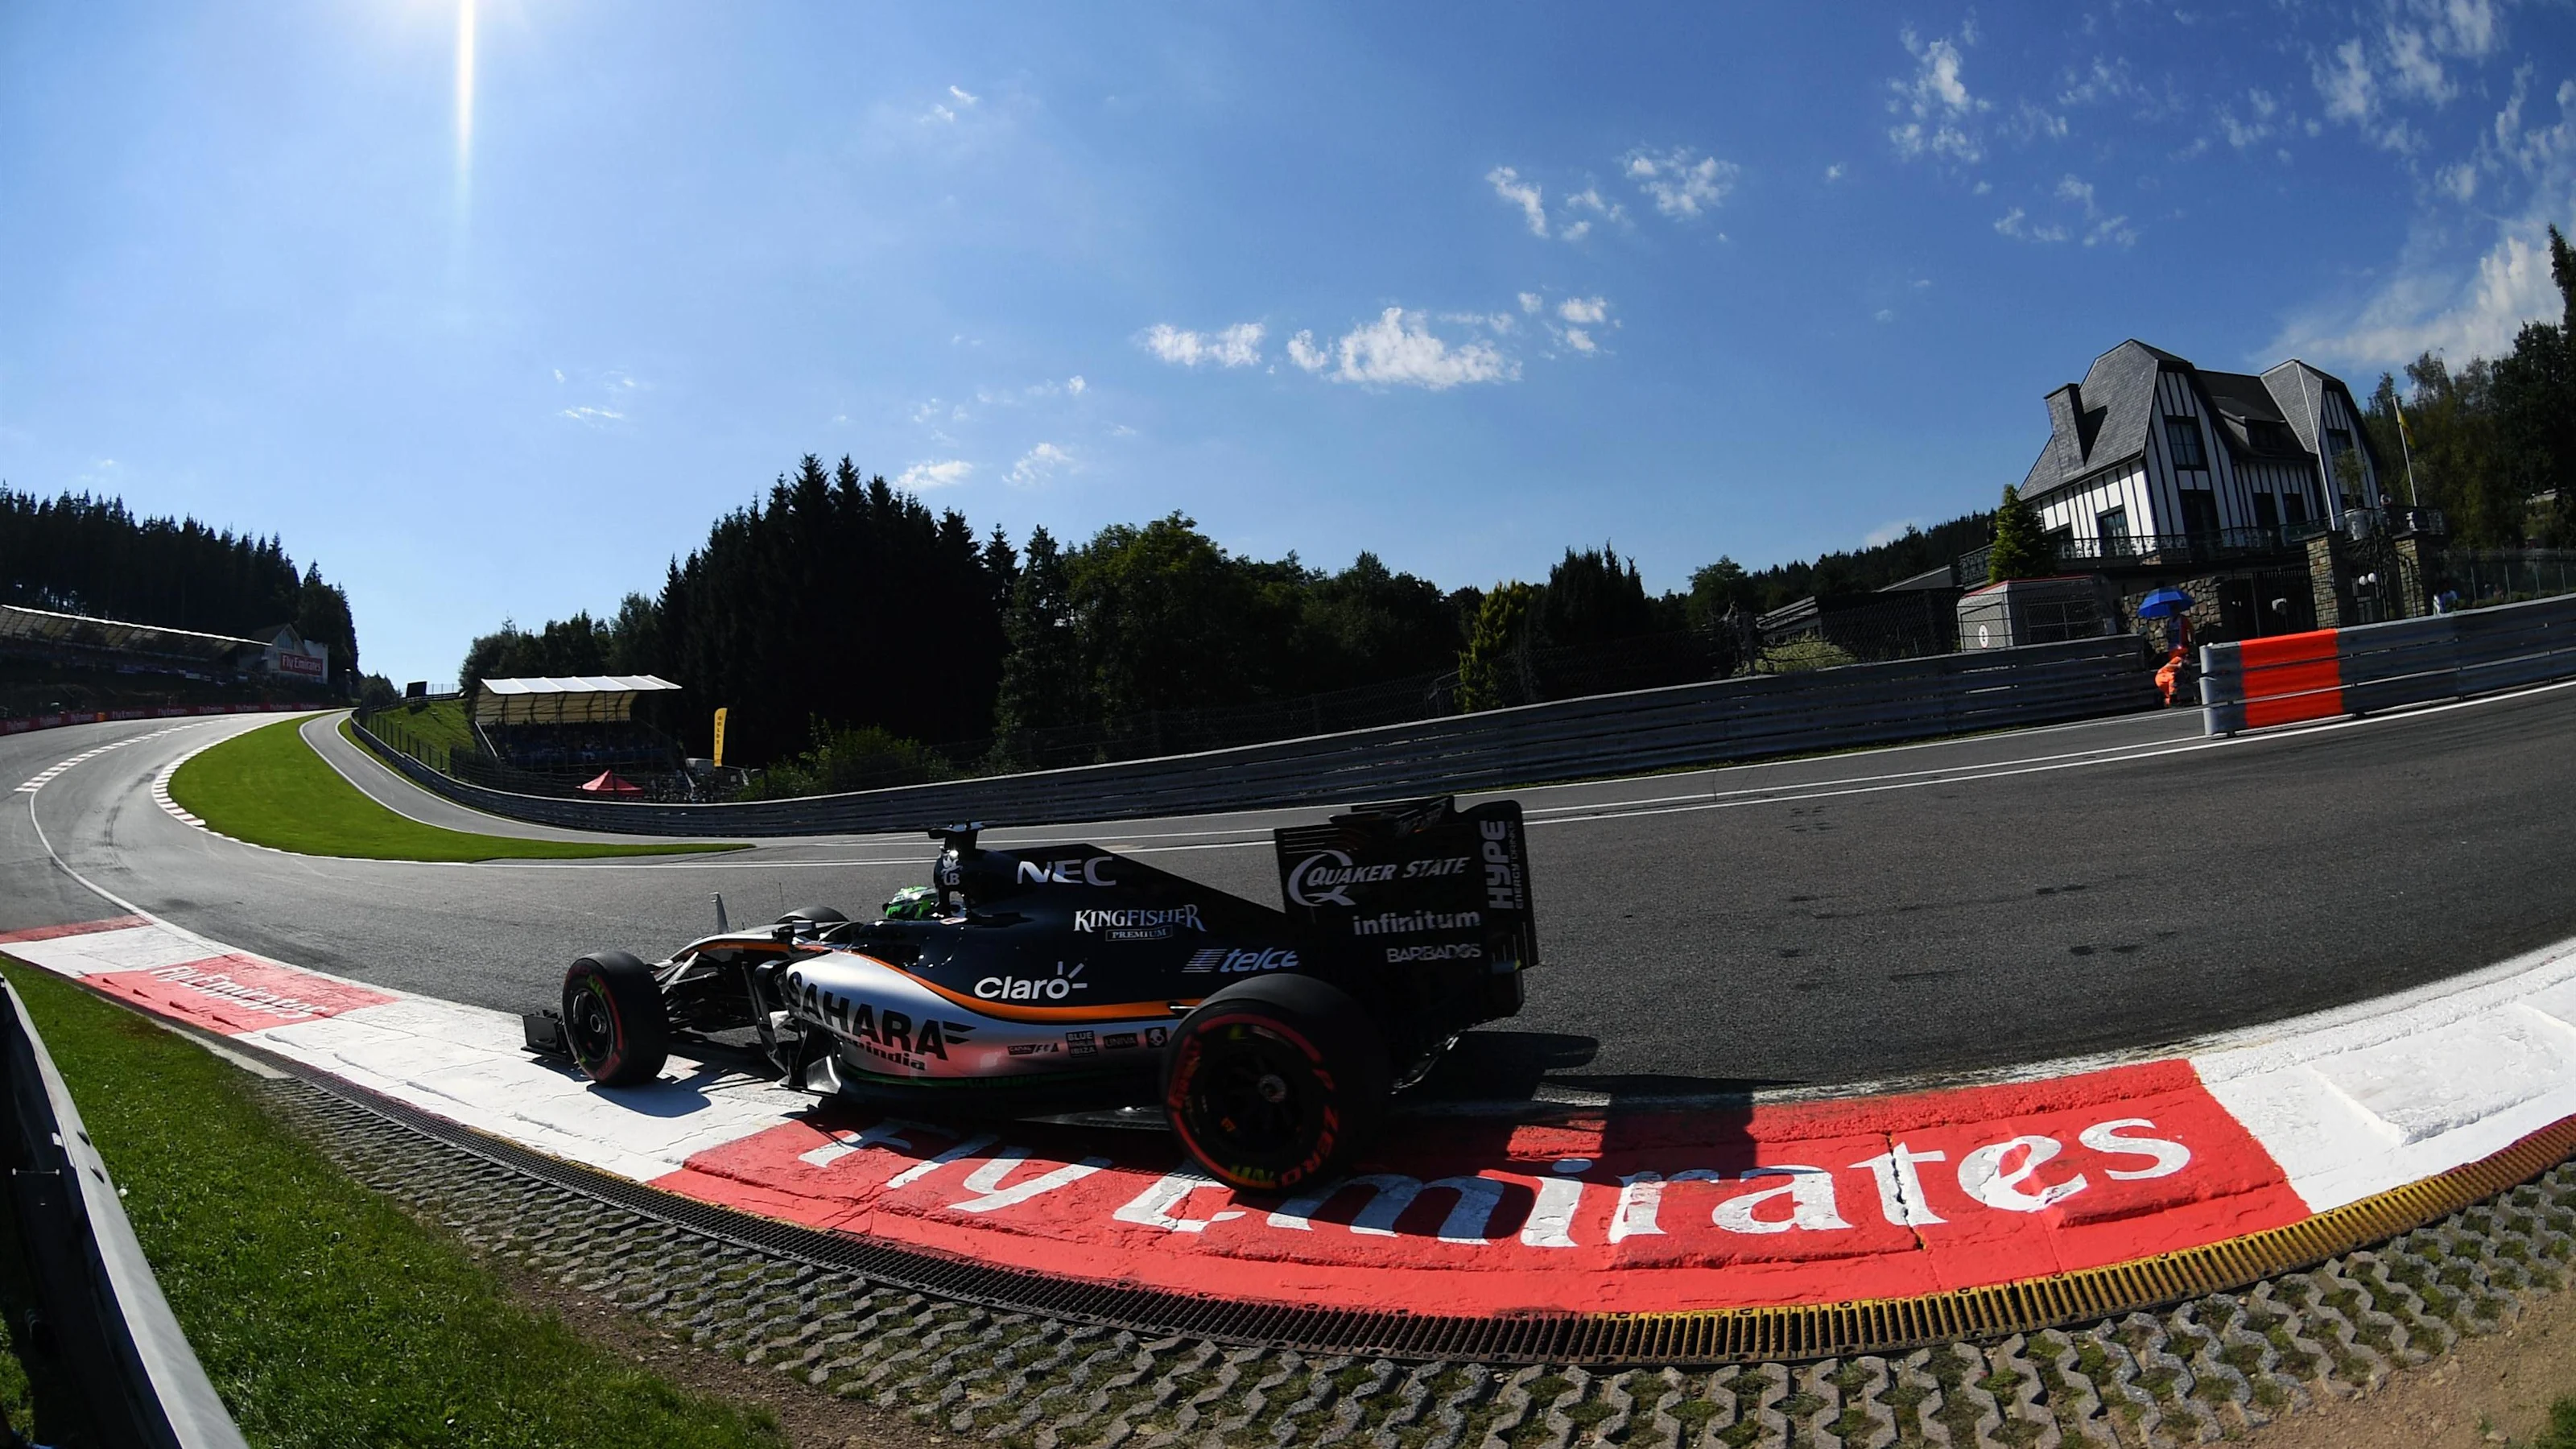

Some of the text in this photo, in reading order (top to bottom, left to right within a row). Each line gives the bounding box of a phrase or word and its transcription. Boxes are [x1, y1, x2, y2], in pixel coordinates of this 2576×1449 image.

[1017, 857, 1117, 886] NEC
[1306, 857, 1472, 887] QUAKER STATE
[1480, 819, 1514, 910] HYPE
[1074, 904, 1207, 932] KINGFISHER
[1352, 910, 1481, 935] infinitum
[1112, 928, 1167, 939] PREMIUM
[1385, 943, 1483, 964] BARBADOS
[974, 976, 1070, 1000] Claro
[787, 972, 948, 1061] SAHARA
[1067, 1031, 1093, 1041] BLUE
[798, 1116, 2193, 1248] Fly Emirates
